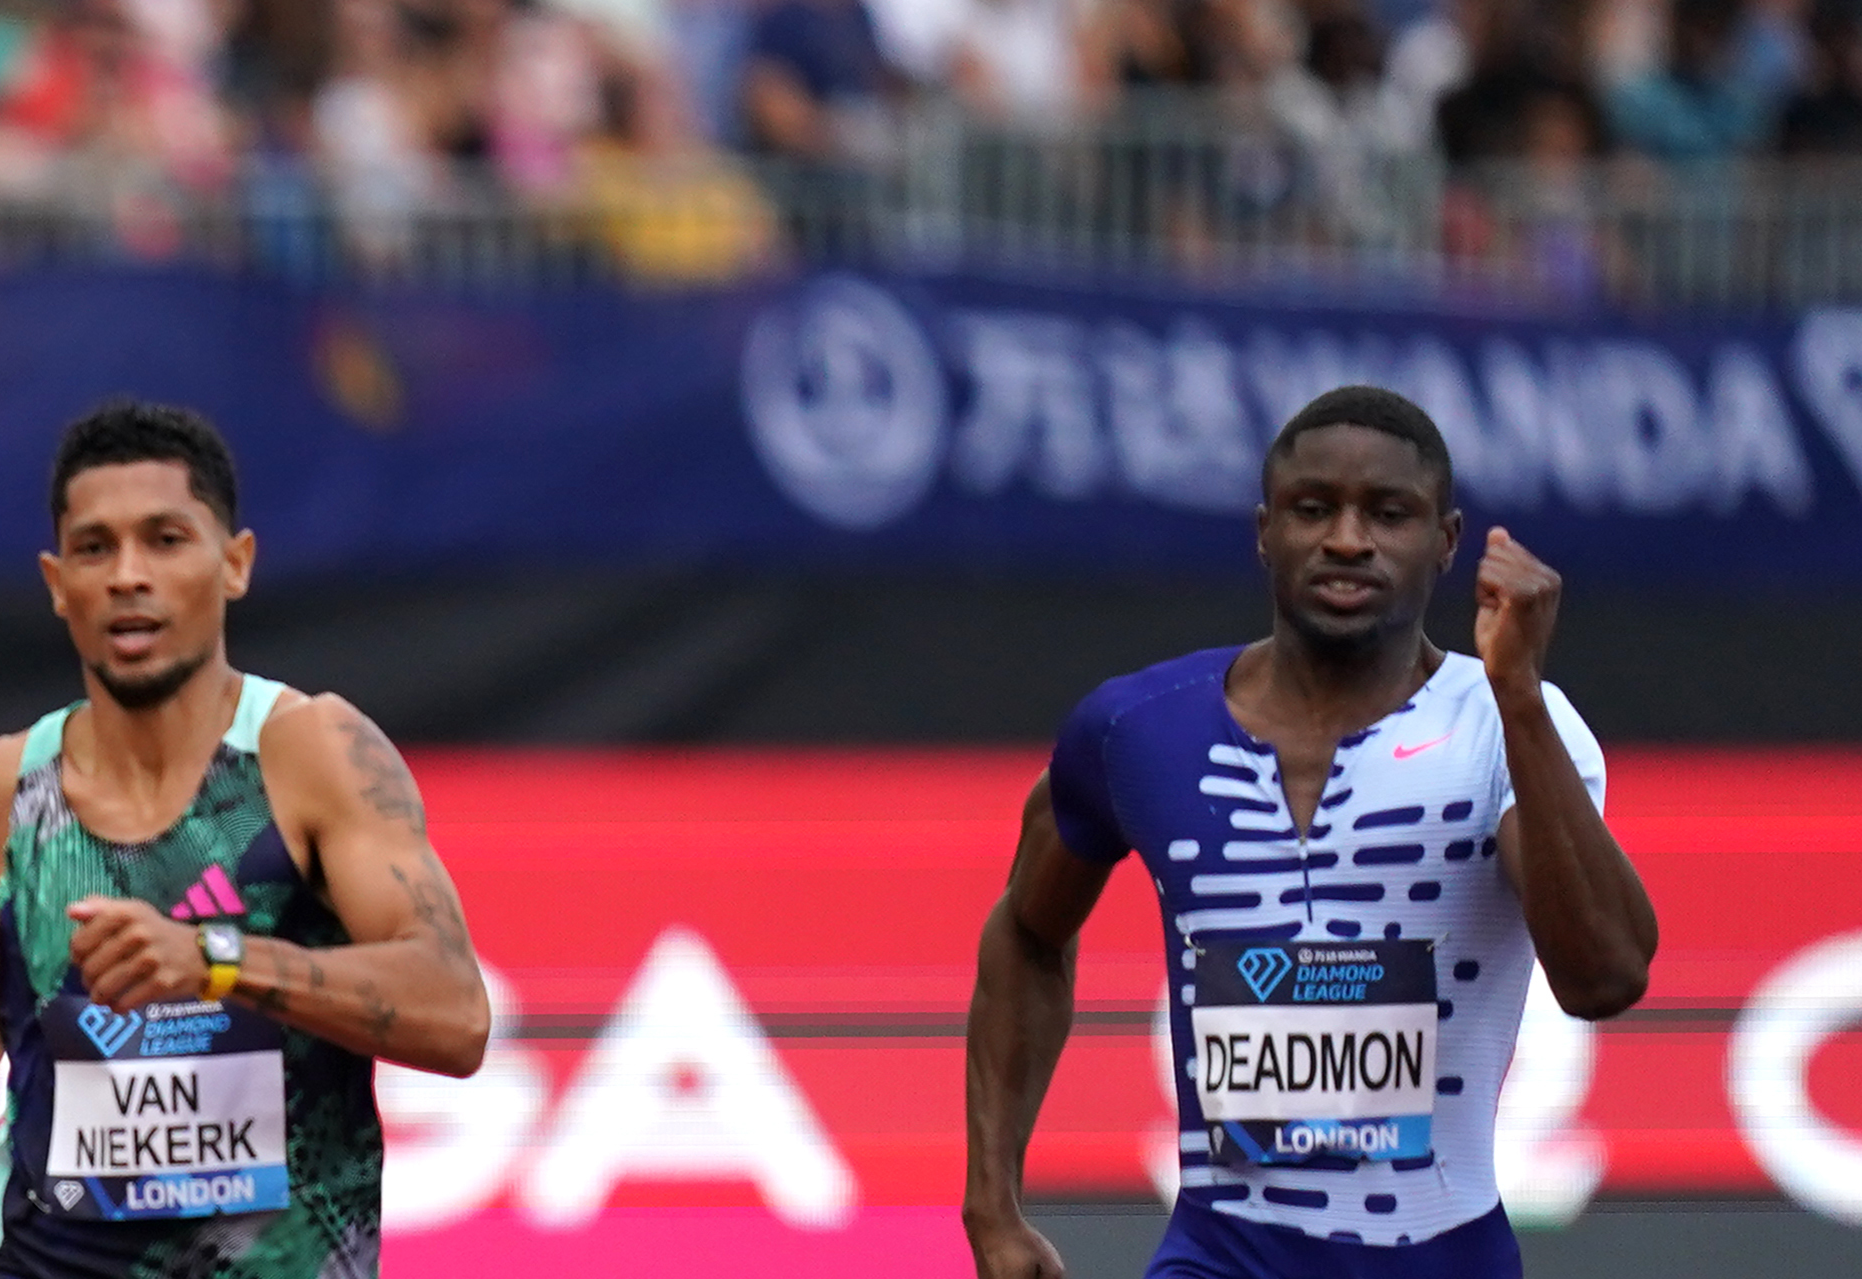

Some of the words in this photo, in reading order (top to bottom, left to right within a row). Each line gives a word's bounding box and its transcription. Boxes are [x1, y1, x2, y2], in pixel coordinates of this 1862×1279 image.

[1297, 964, 1385, 982] DIAMOND
[1293, 983, 1367, 1001] LEAGUE
[1205, 1031, 1423, 1092] DEADMON
[111, 1071, 199, 1116] VAN
[75, 1117, 258, 1169] NIEKERK
[1275, 1123, 1400, 1154] LONDON
[125, 1174, 256, 1211] LONDON
